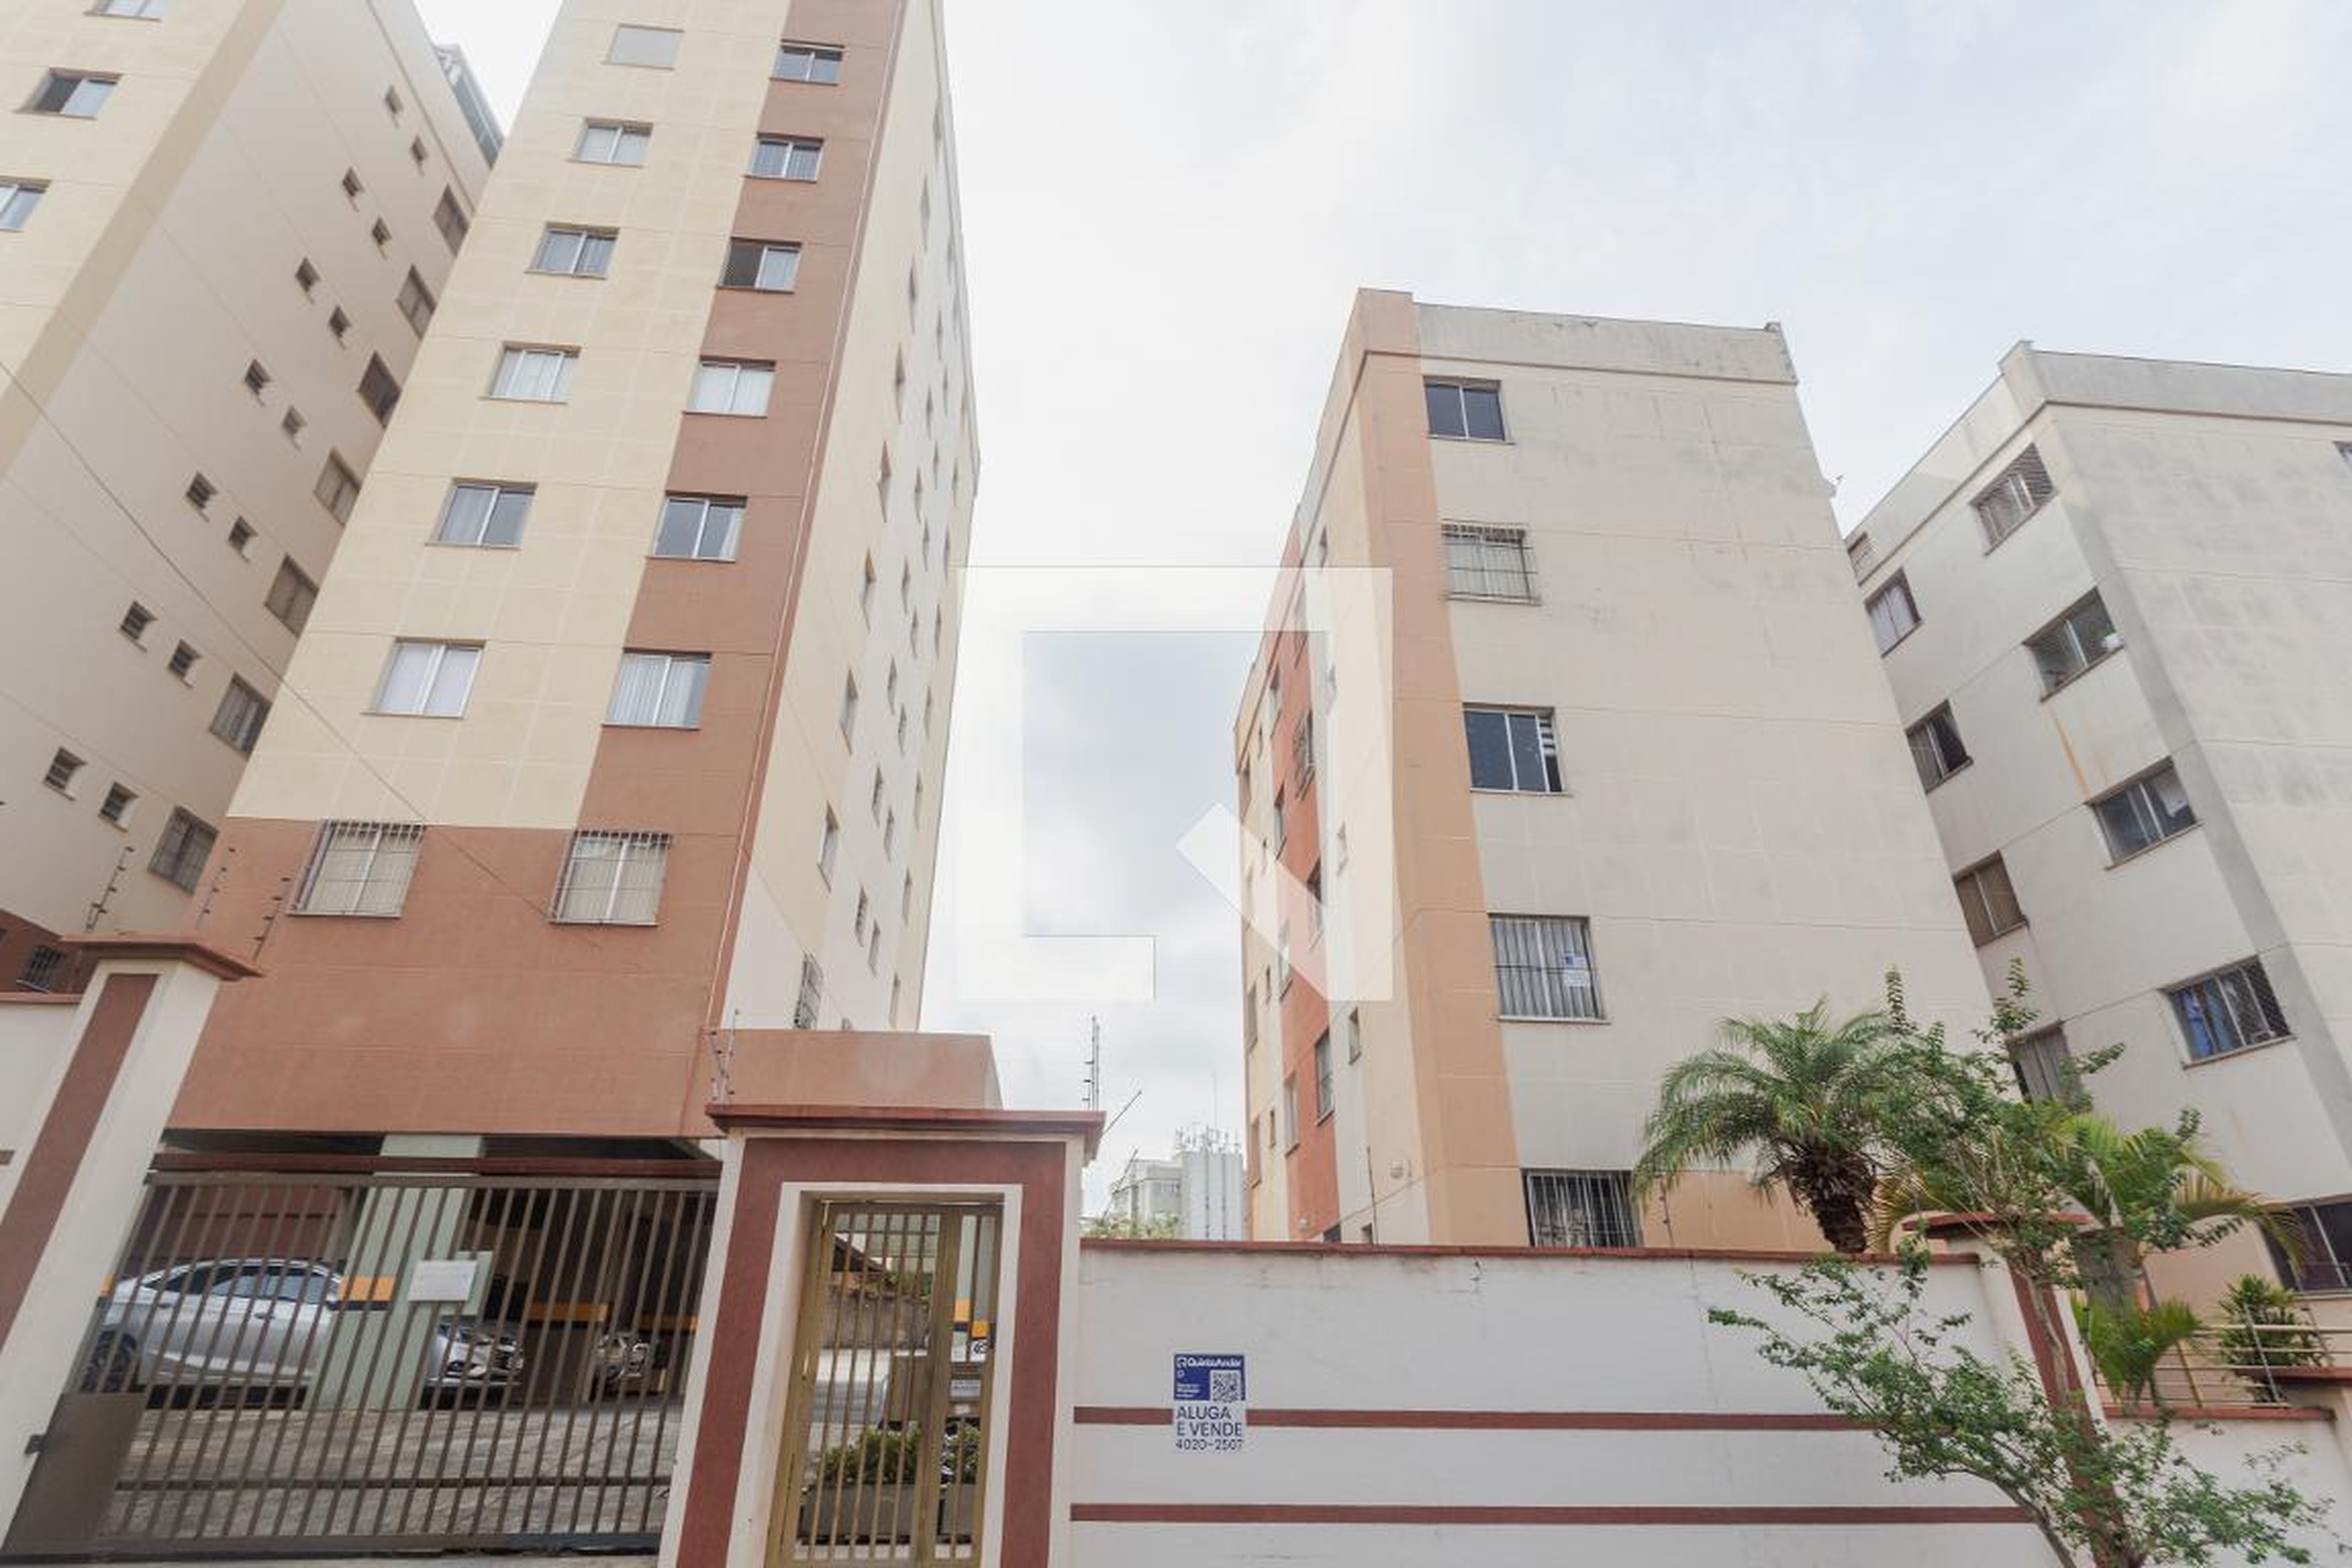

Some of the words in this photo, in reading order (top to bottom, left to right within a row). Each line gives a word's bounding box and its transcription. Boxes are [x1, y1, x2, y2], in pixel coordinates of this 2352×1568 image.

[1176, 1406, 1232, 1419] ALUGA
[1177, 1422, 1185, 1436] E
[1189, 1422, 1242, 1436] VENDE
[1175, 1439, 1243, 1450] 4020-2507
